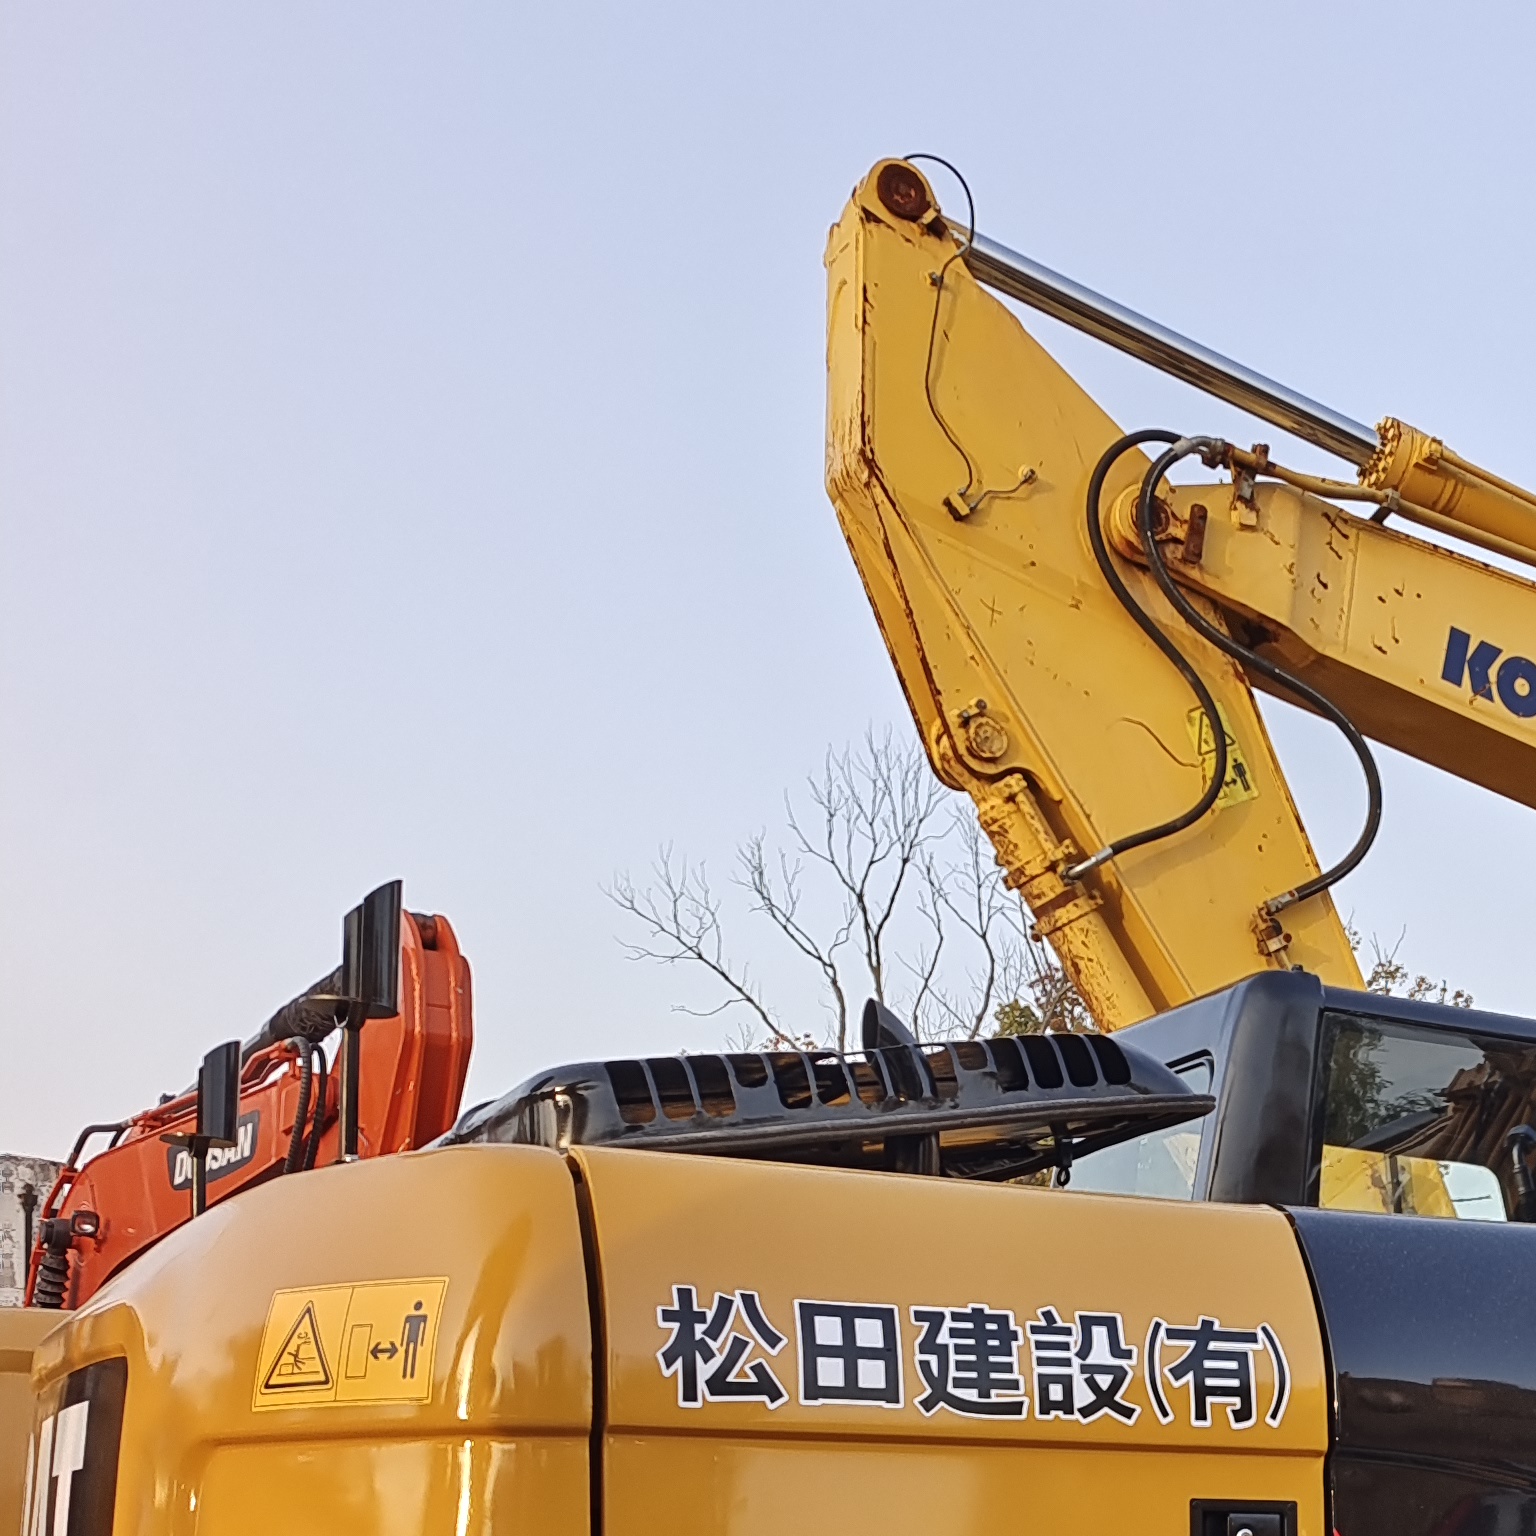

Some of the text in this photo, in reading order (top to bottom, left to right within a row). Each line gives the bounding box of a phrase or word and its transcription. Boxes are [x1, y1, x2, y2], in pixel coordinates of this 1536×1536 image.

[656, 1284, 1292, 1429] 松田建設(有)
